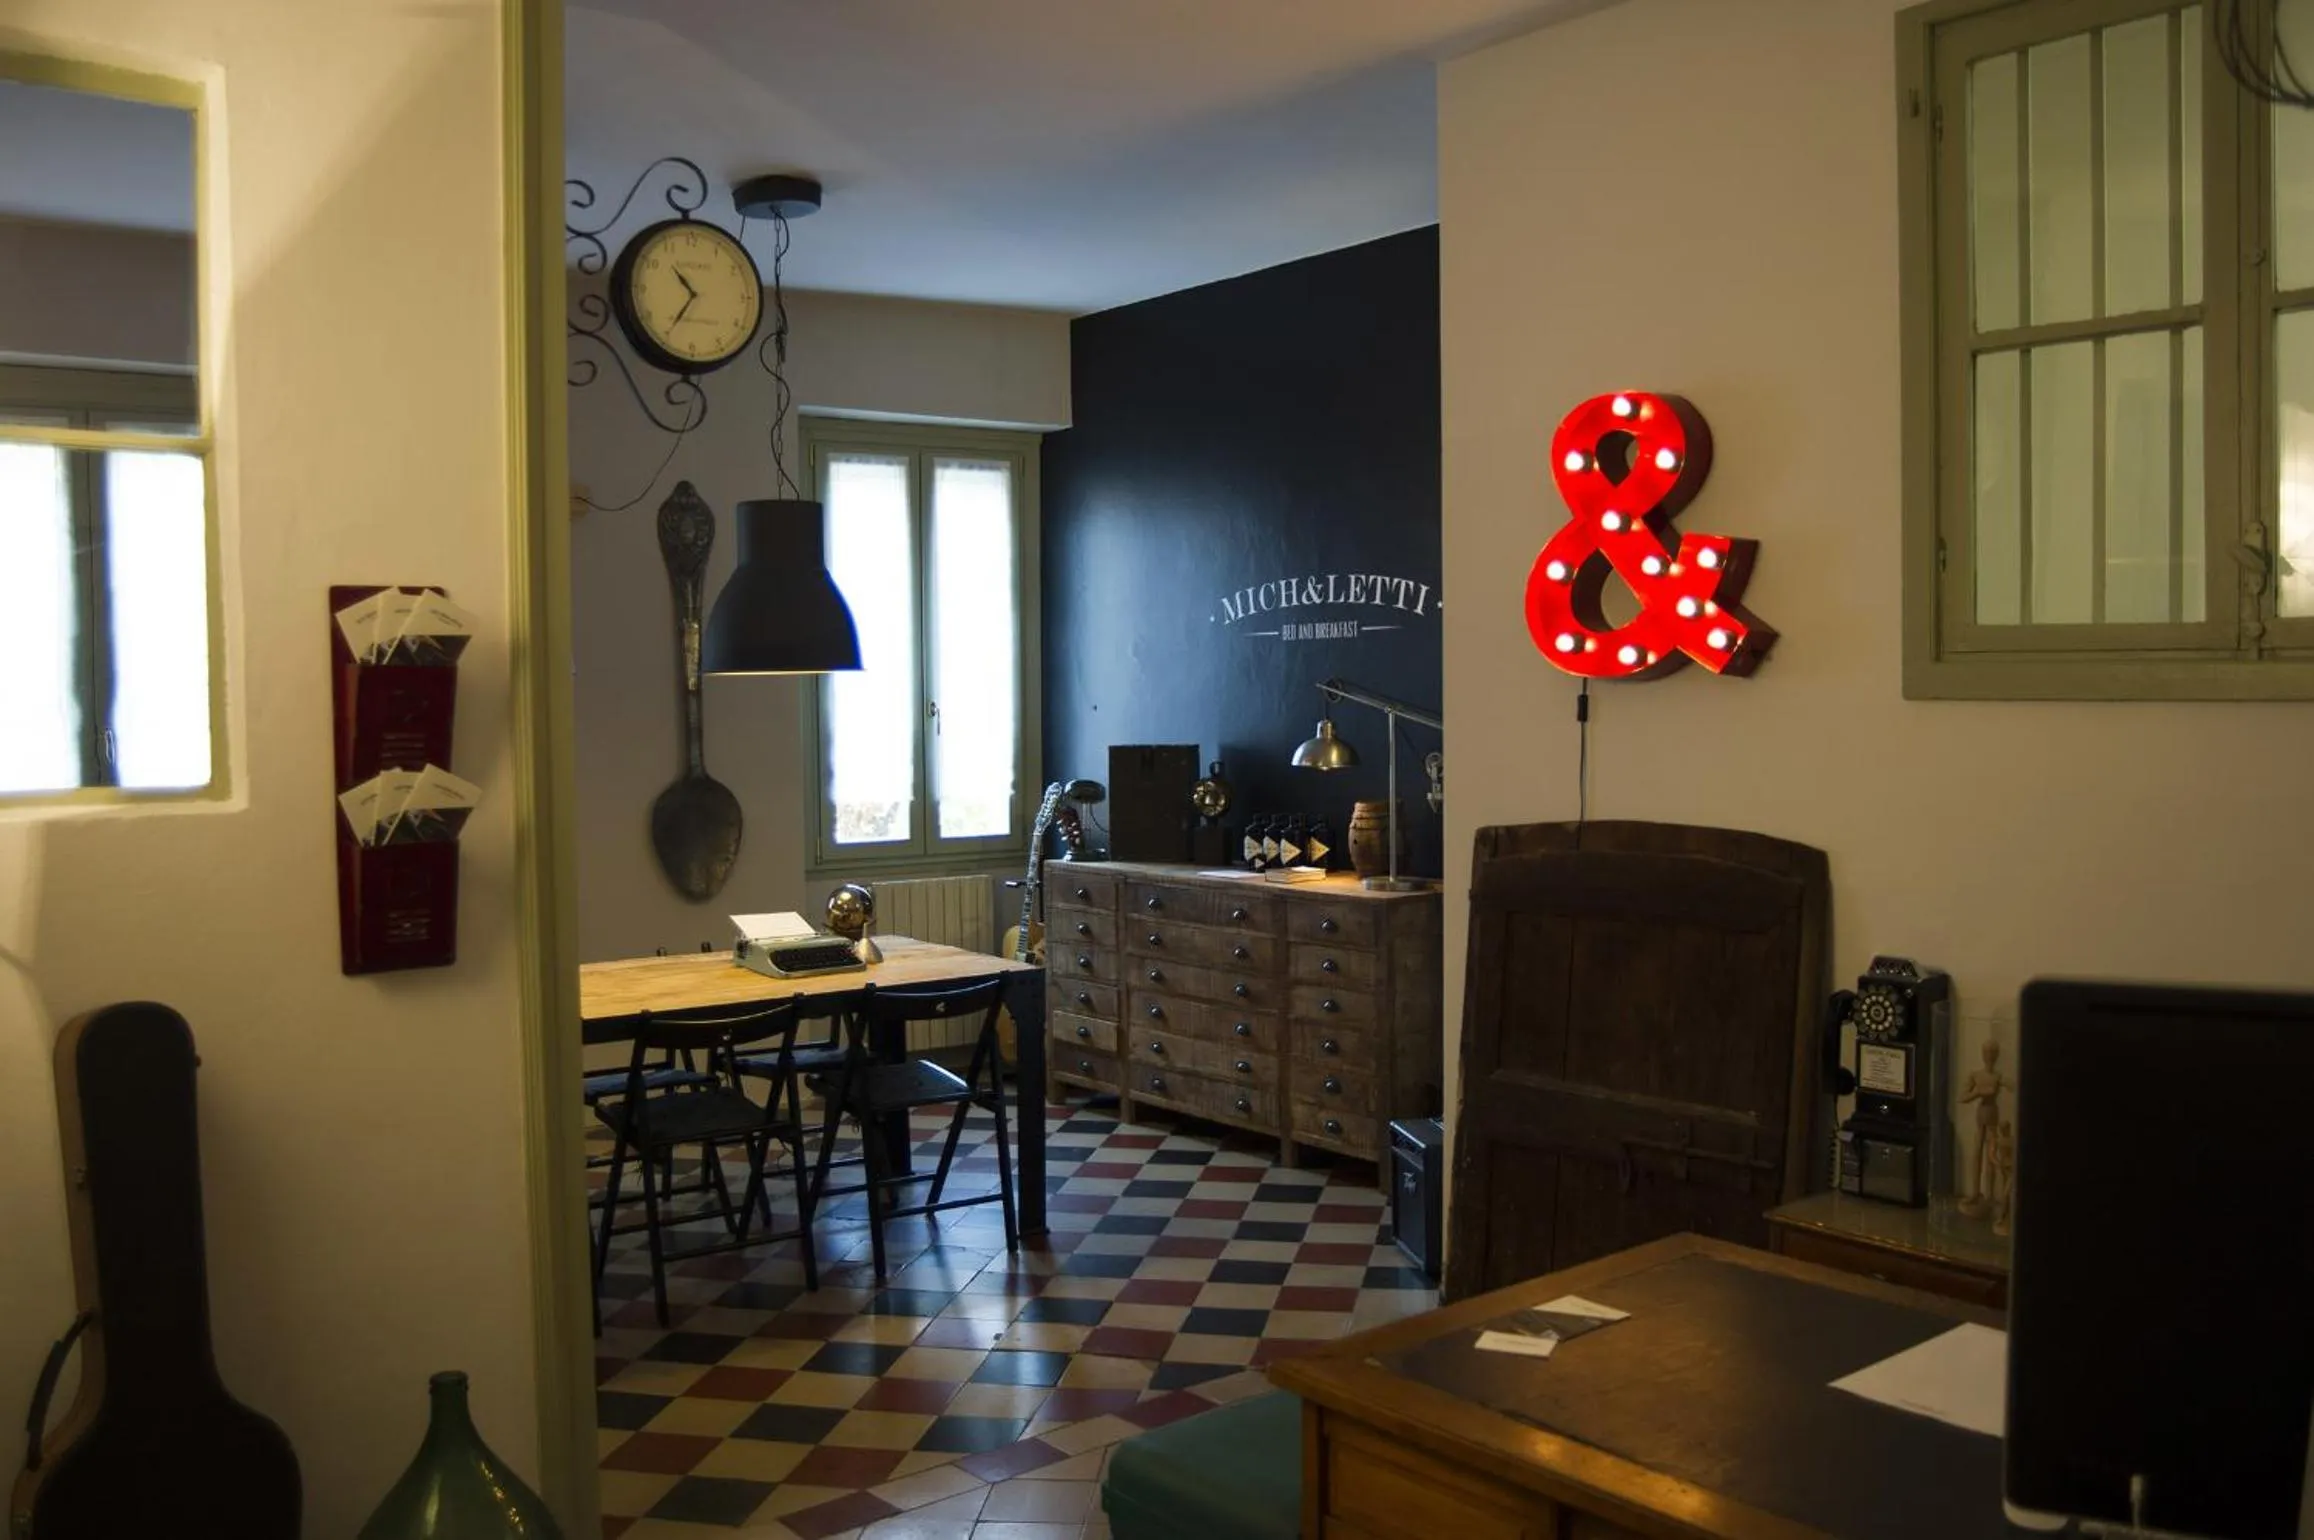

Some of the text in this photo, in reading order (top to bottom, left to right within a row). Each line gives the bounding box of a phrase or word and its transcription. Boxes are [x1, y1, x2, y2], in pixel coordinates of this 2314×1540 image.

[1525, 389, 1774, 678] &
[1221, 573, 1430, 625] MICH&LETTI
[1298, 622, 1314, 640] AND
[1315, 620, 1358, 640] BREAKFAST
